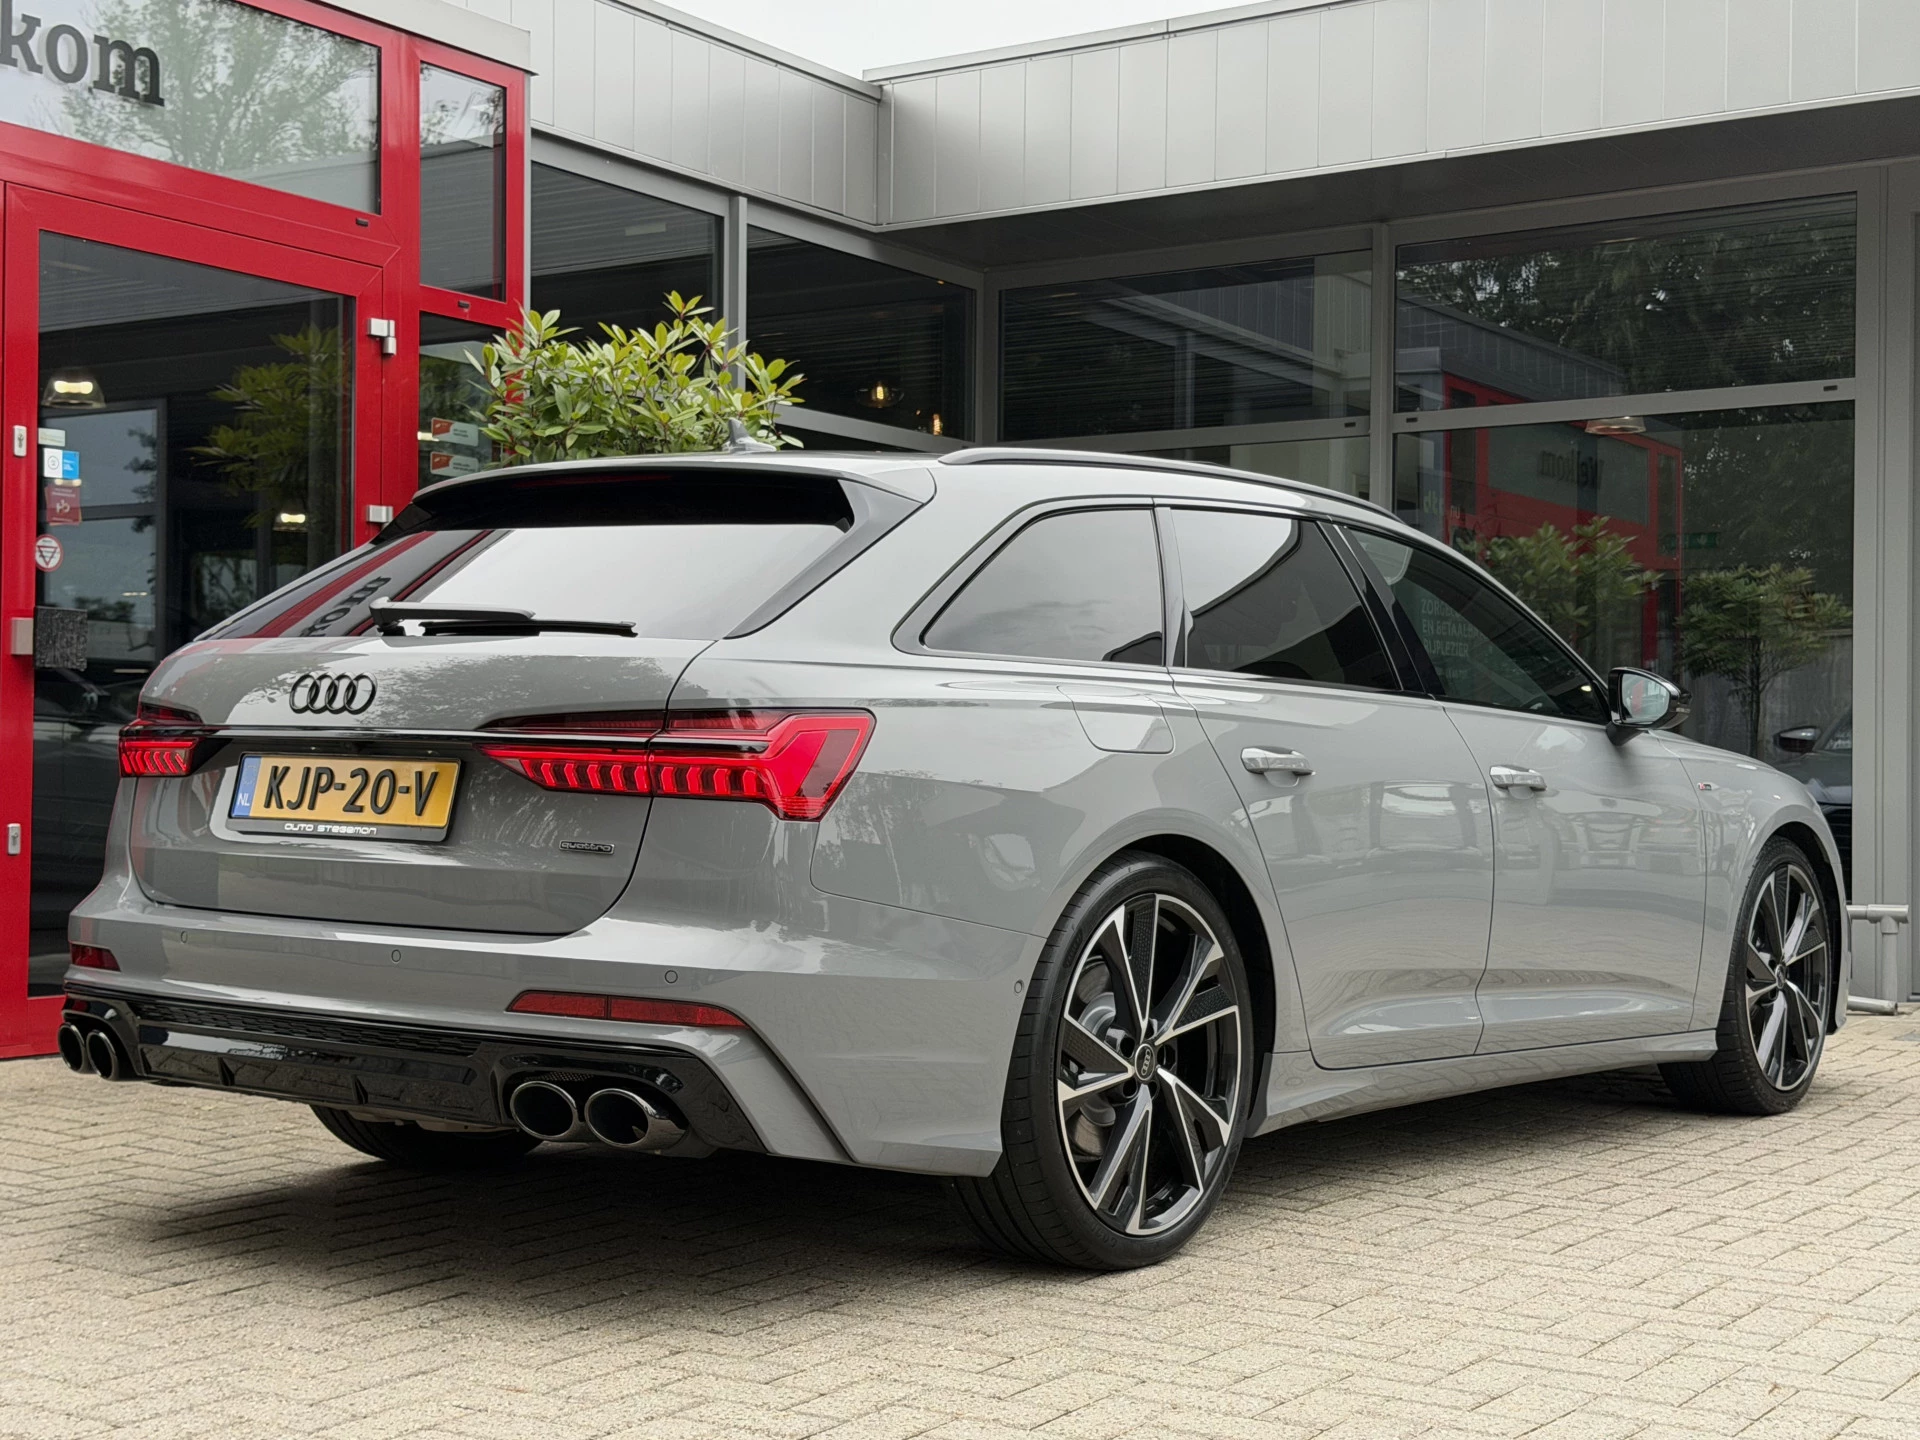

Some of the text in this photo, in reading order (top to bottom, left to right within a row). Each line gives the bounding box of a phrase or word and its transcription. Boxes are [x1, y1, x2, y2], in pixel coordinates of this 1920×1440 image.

[0, 0, 165, 106] kom
[237, 765, 438, 816] NL KJP-20-V
[561, 842, 611, 852] quattro
